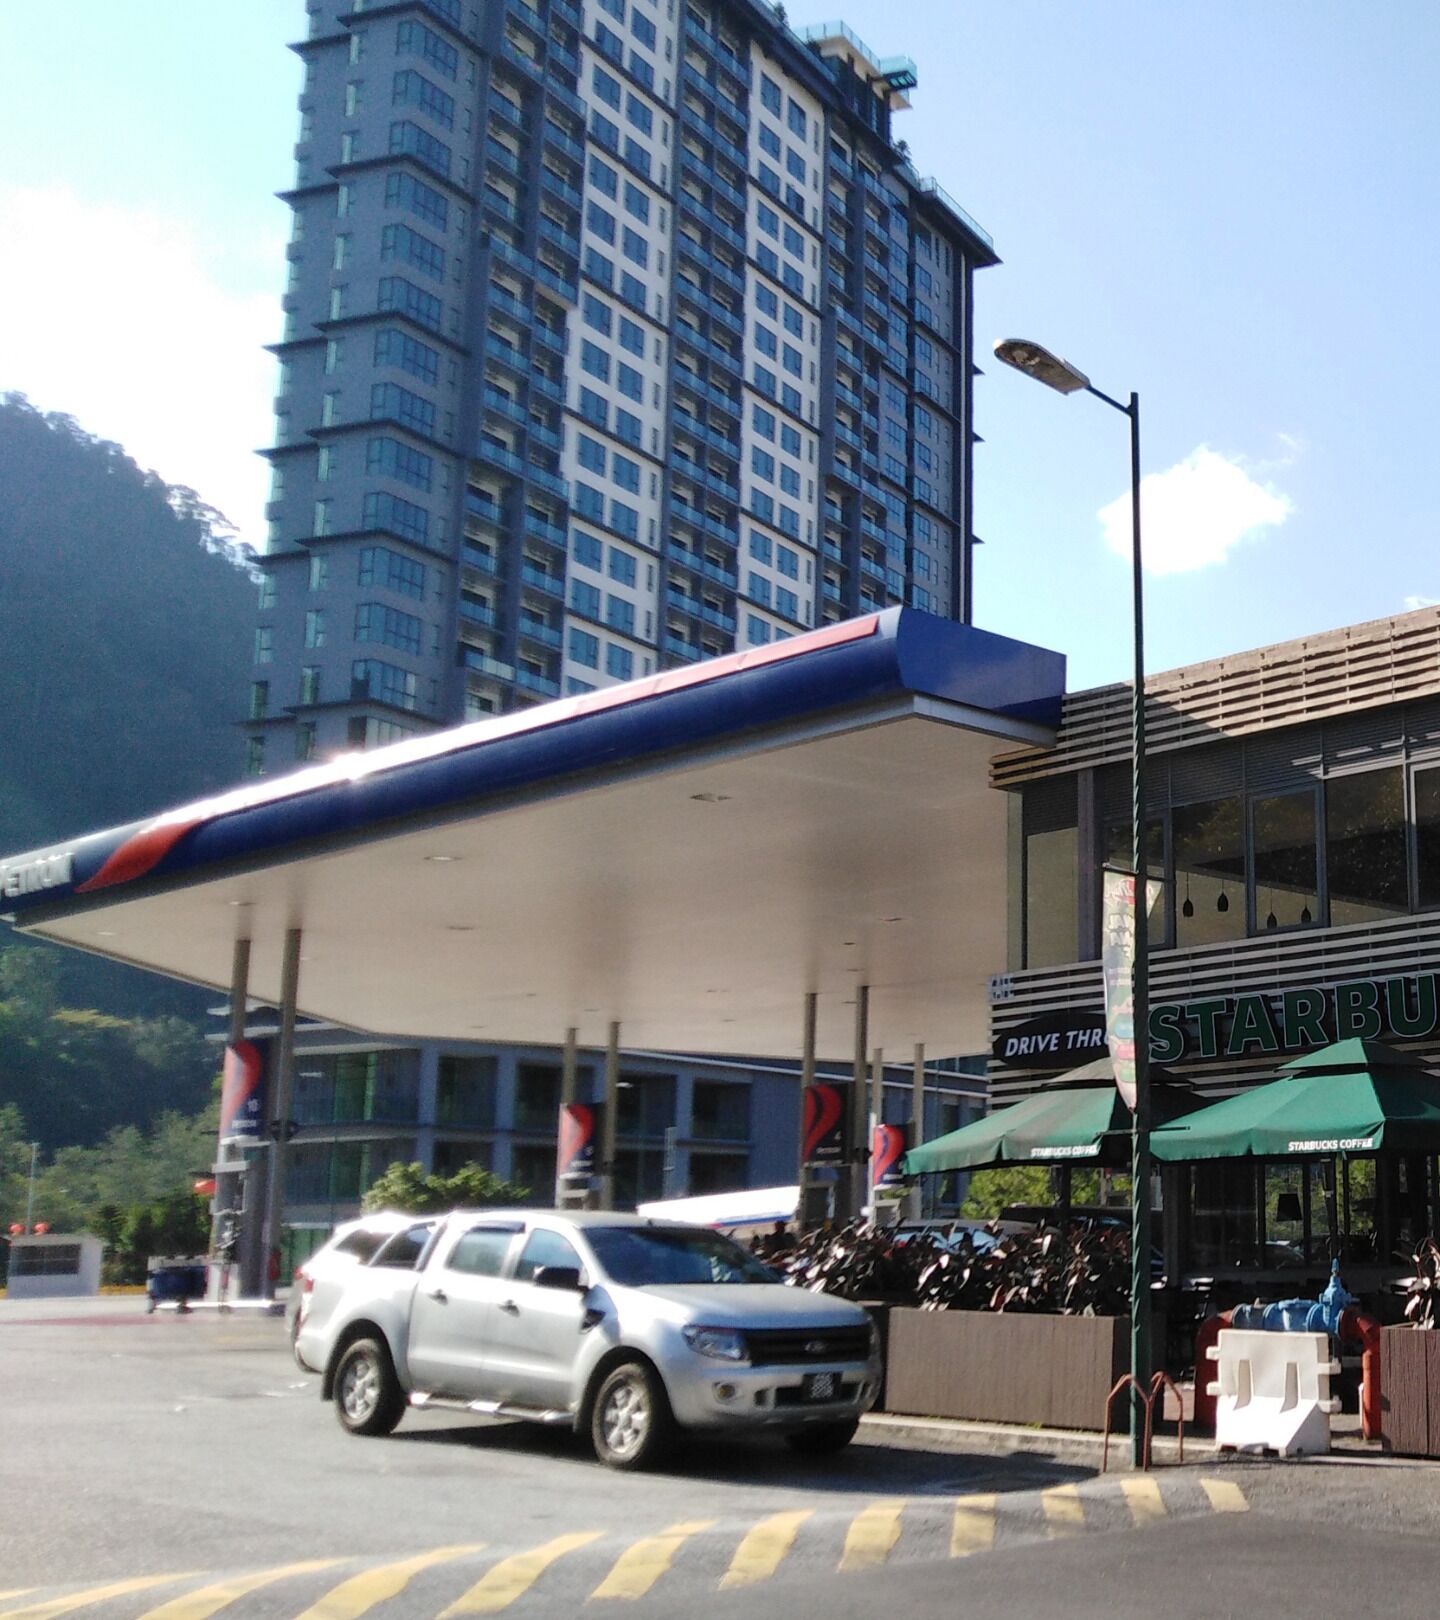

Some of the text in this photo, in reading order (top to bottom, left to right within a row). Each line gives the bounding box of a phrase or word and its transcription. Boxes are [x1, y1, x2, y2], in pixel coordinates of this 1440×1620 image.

[1004, 1032, 1061, 1057] DRIVE
[1288, 1137, 1374, 1152] STARBUCKS COFFEE
